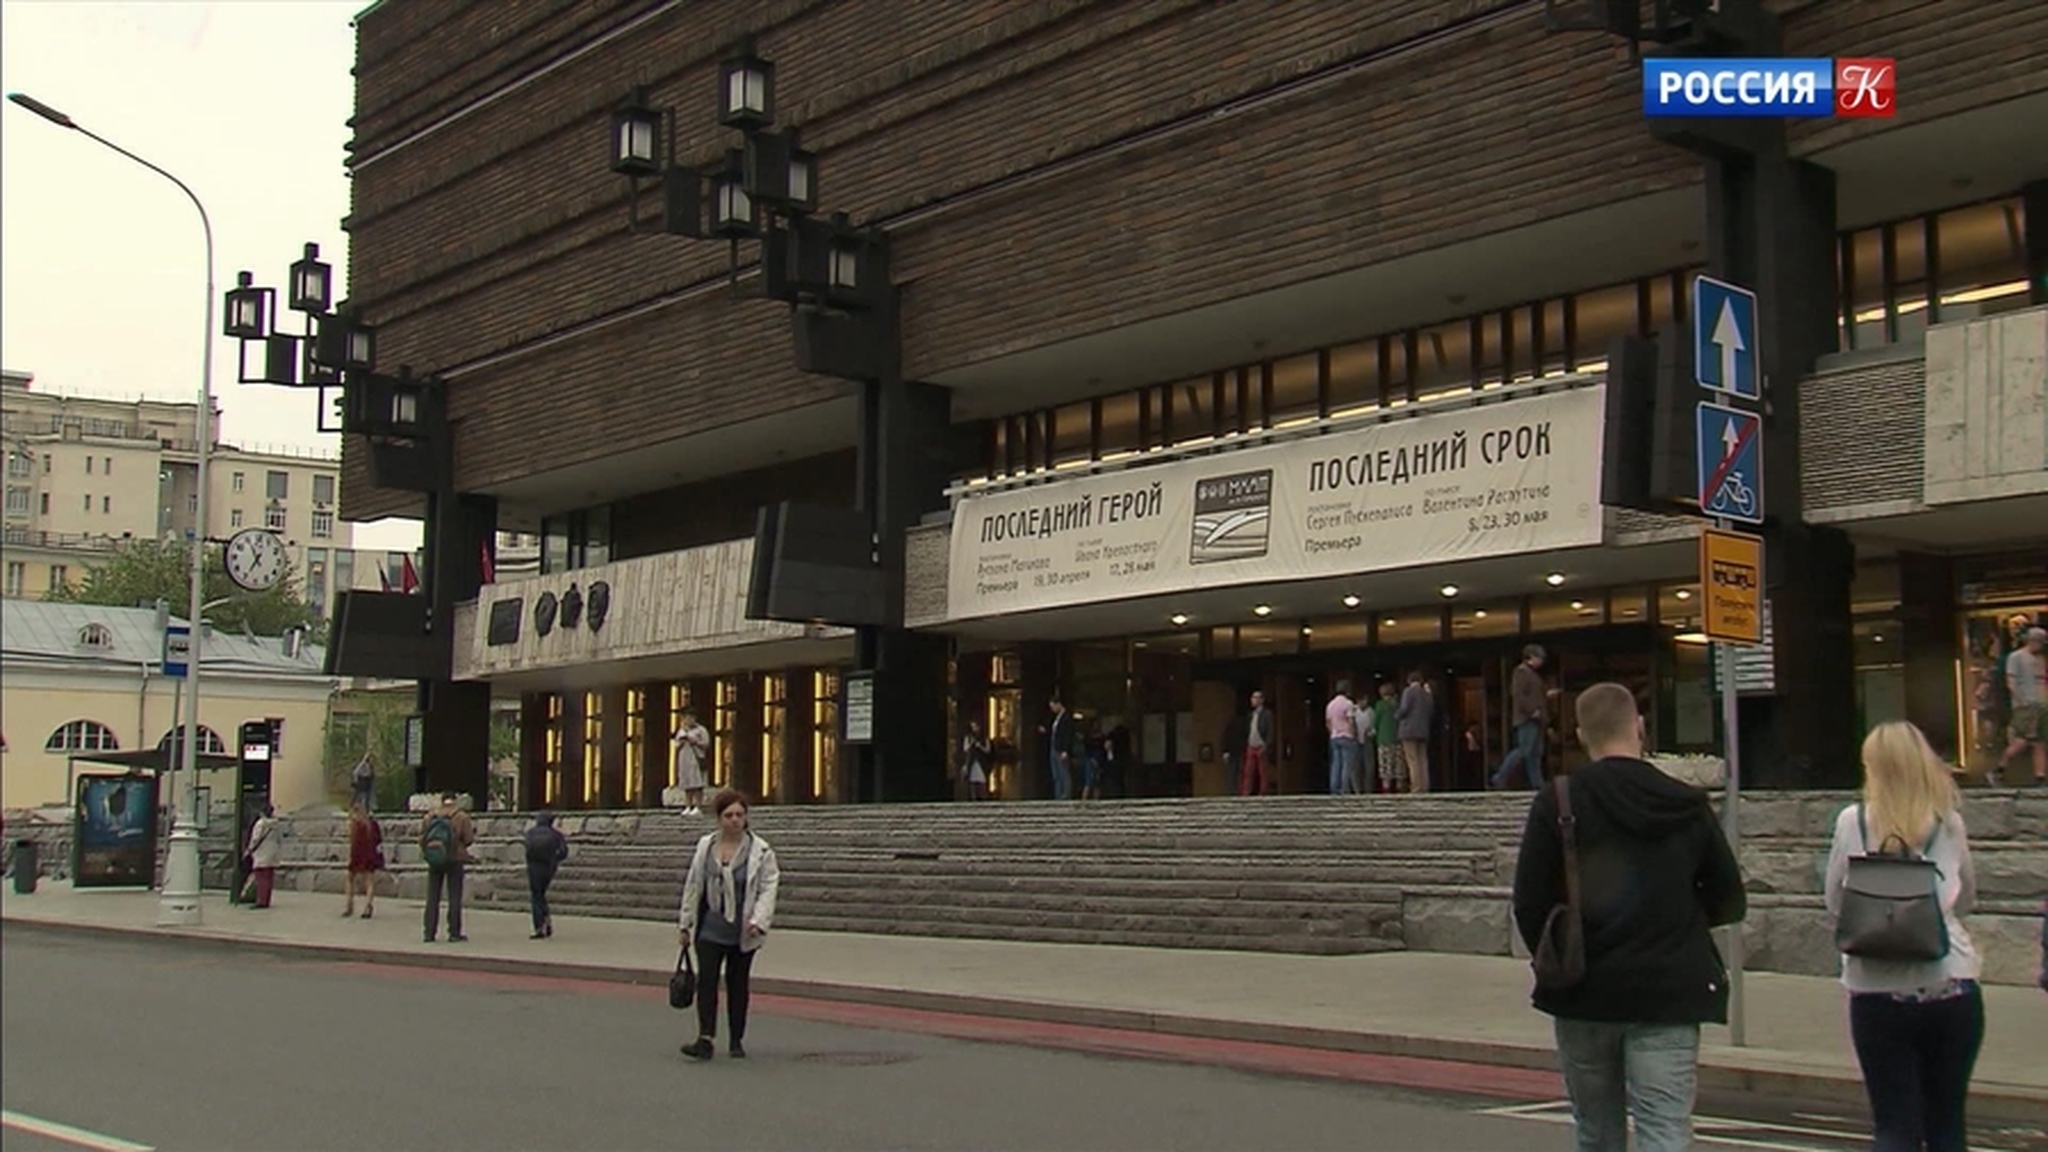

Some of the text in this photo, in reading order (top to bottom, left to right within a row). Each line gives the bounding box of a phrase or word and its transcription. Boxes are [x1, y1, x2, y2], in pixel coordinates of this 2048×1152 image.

[1309, 422, 1552, 492] ПОСЛЕДНИЙ СРОК
[981, 482, 1163, 543] ПОСЛЕДНИЙ ГЕРОЙ
[1304, 535, 1362, 554] Премьера
